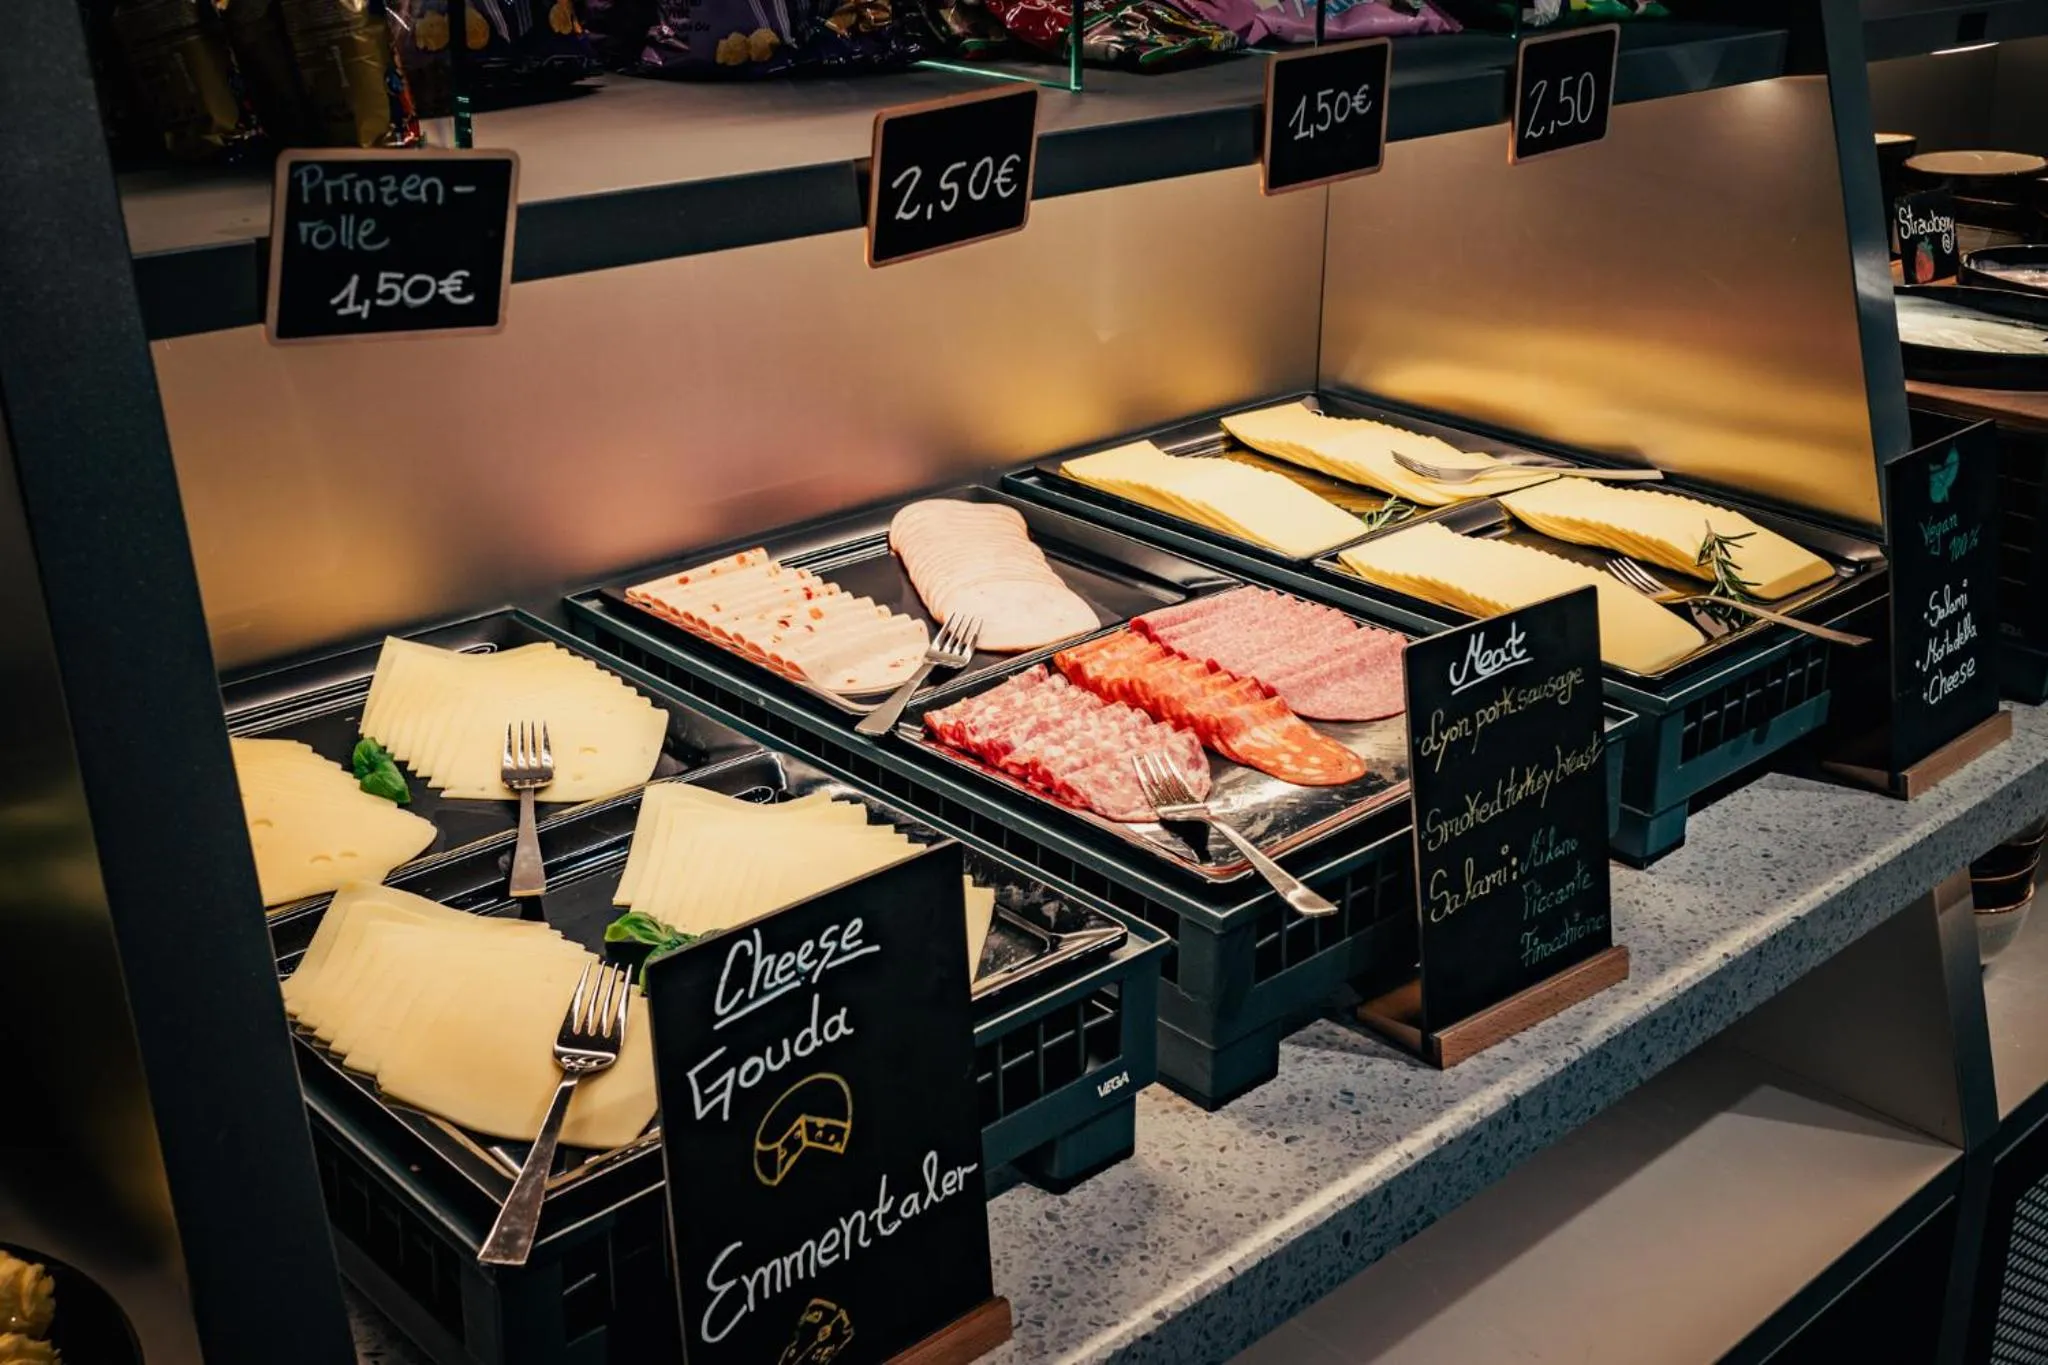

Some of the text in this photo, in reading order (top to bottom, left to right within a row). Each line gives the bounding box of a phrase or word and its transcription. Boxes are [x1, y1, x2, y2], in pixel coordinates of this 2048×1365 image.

[1288, 84, 1373, 141] 1,50€
[1525, 71, 1595, 139] 2,50
[891, 153, 1021, 220] 2,50€
[298, 213, 391, 250] rolle
[329, 269, 476, 319] 1,50€
[1916, 511, 1959, 557] Vegan
[1449, 620, 1528, 686] Meat
[1928, 656, 1977, 705] Cheese
[1420, 707, 1473, 774] Lyon
[1517, 666, 1585, 710] sausage
[1426, 729, 1606, 852] Smoked turkey breast
[1521, 859, 1596, 922] Piccante
[713, 916, 865, 1017] Cheese
[686, 992, 856, 1122] Gouda
[1096, 1070, 1131, 1099] VEGA
[701, 1149, 979, 1344] Emmentaler
